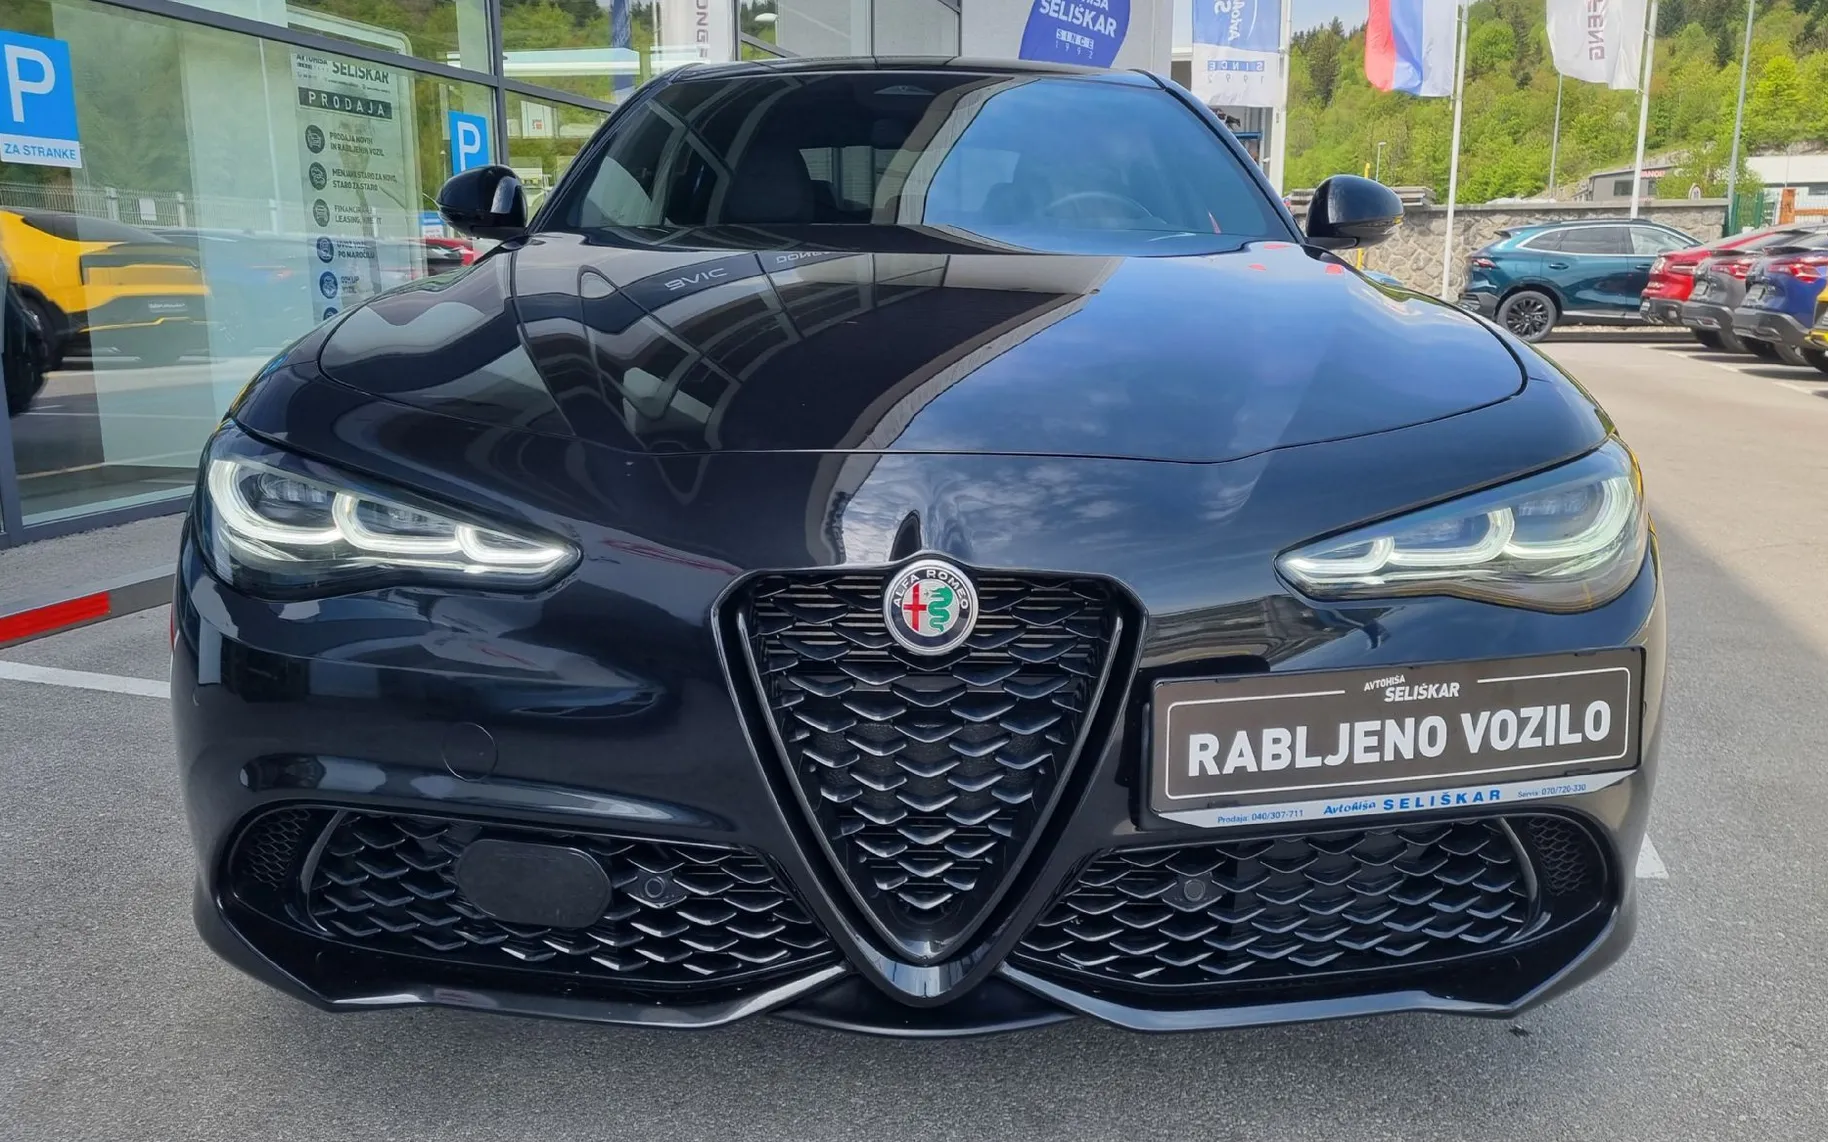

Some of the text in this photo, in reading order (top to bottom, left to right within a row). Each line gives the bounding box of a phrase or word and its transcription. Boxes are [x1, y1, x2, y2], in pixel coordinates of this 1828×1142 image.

[1039, 0, 1117, 38] SELIŠKAR
[1056, 29, 1094, 49] SINCE
[1056, 40, 1093, 59] 1992
[4, 44, 55, 123] P
[308, 91, 385, 117] PRODAJA
[4, 142, 77, 160] ZA STRANKE
[893, 569, 969, 609] ALFA ROMEO
[1363, 674, 1406, 692] AVTOHIŠA
[1384, 682, 1460, 702] SELIŠKAR
[1188, 700, 1611, 777] RABLJENO VOZILO
[1383, 789, 1501, 811] SELIŠKAR
[1251, 809, 1304, 821] 040/307-711
